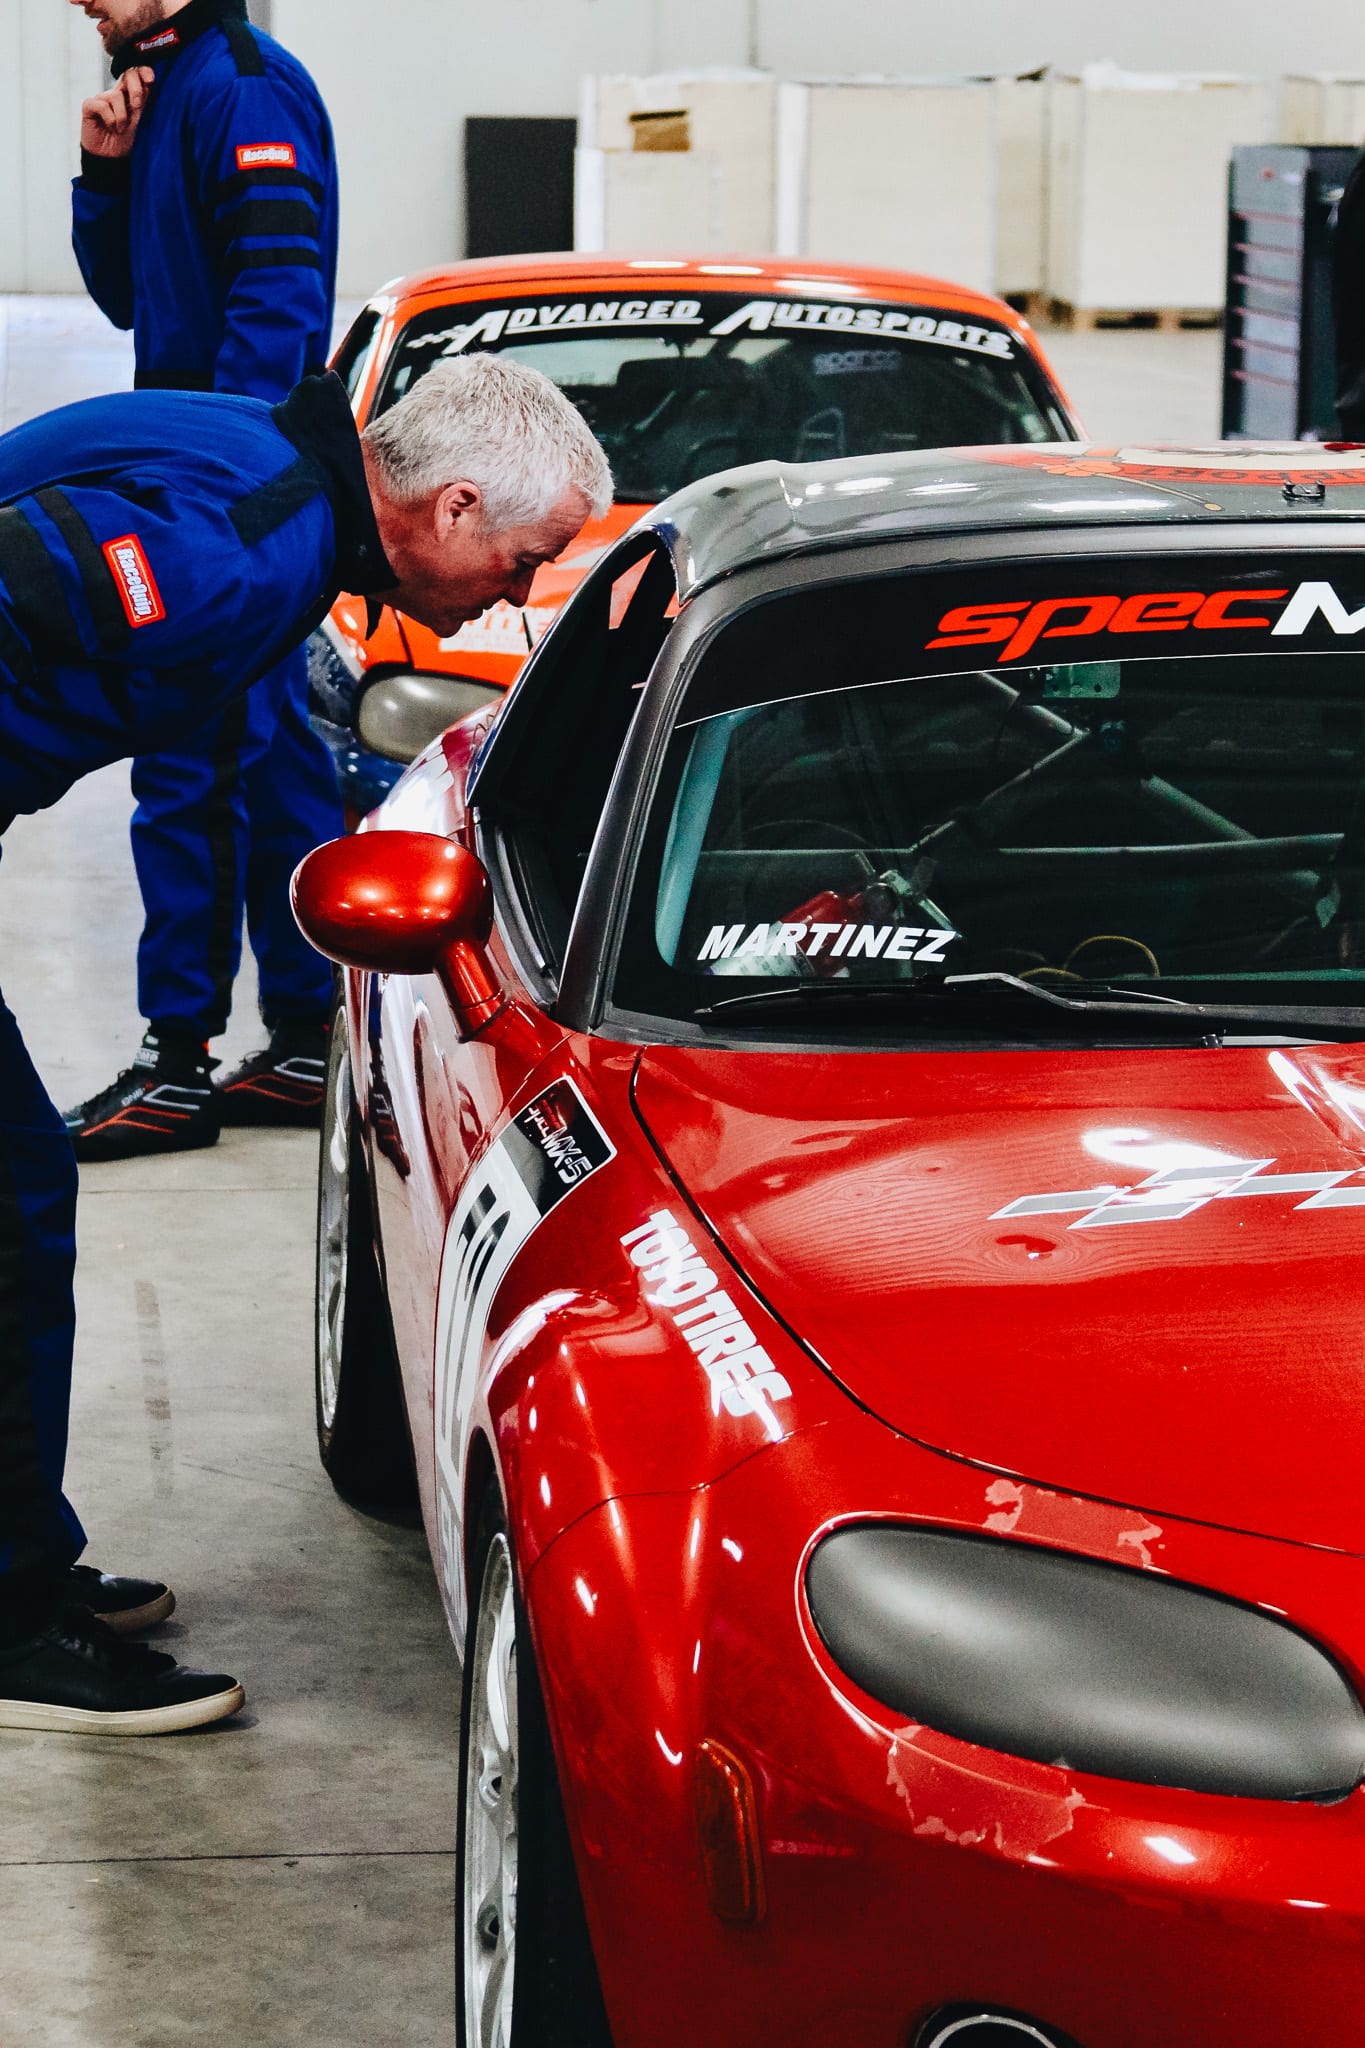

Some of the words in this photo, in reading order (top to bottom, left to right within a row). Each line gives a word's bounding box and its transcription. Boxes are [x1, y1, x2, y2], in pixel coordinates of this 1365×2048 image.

[441, 300, 704, 355] ADVANCED
[709, 300, 1014, 358] AUTOSPORTS
[115, 547, 152, 616] RaceQuip
[697, 923, 956, 962] MARTINEZ
[619, 1208, 719, 1307] TOYO
[672, 1289, 793, 1418] TIRES
